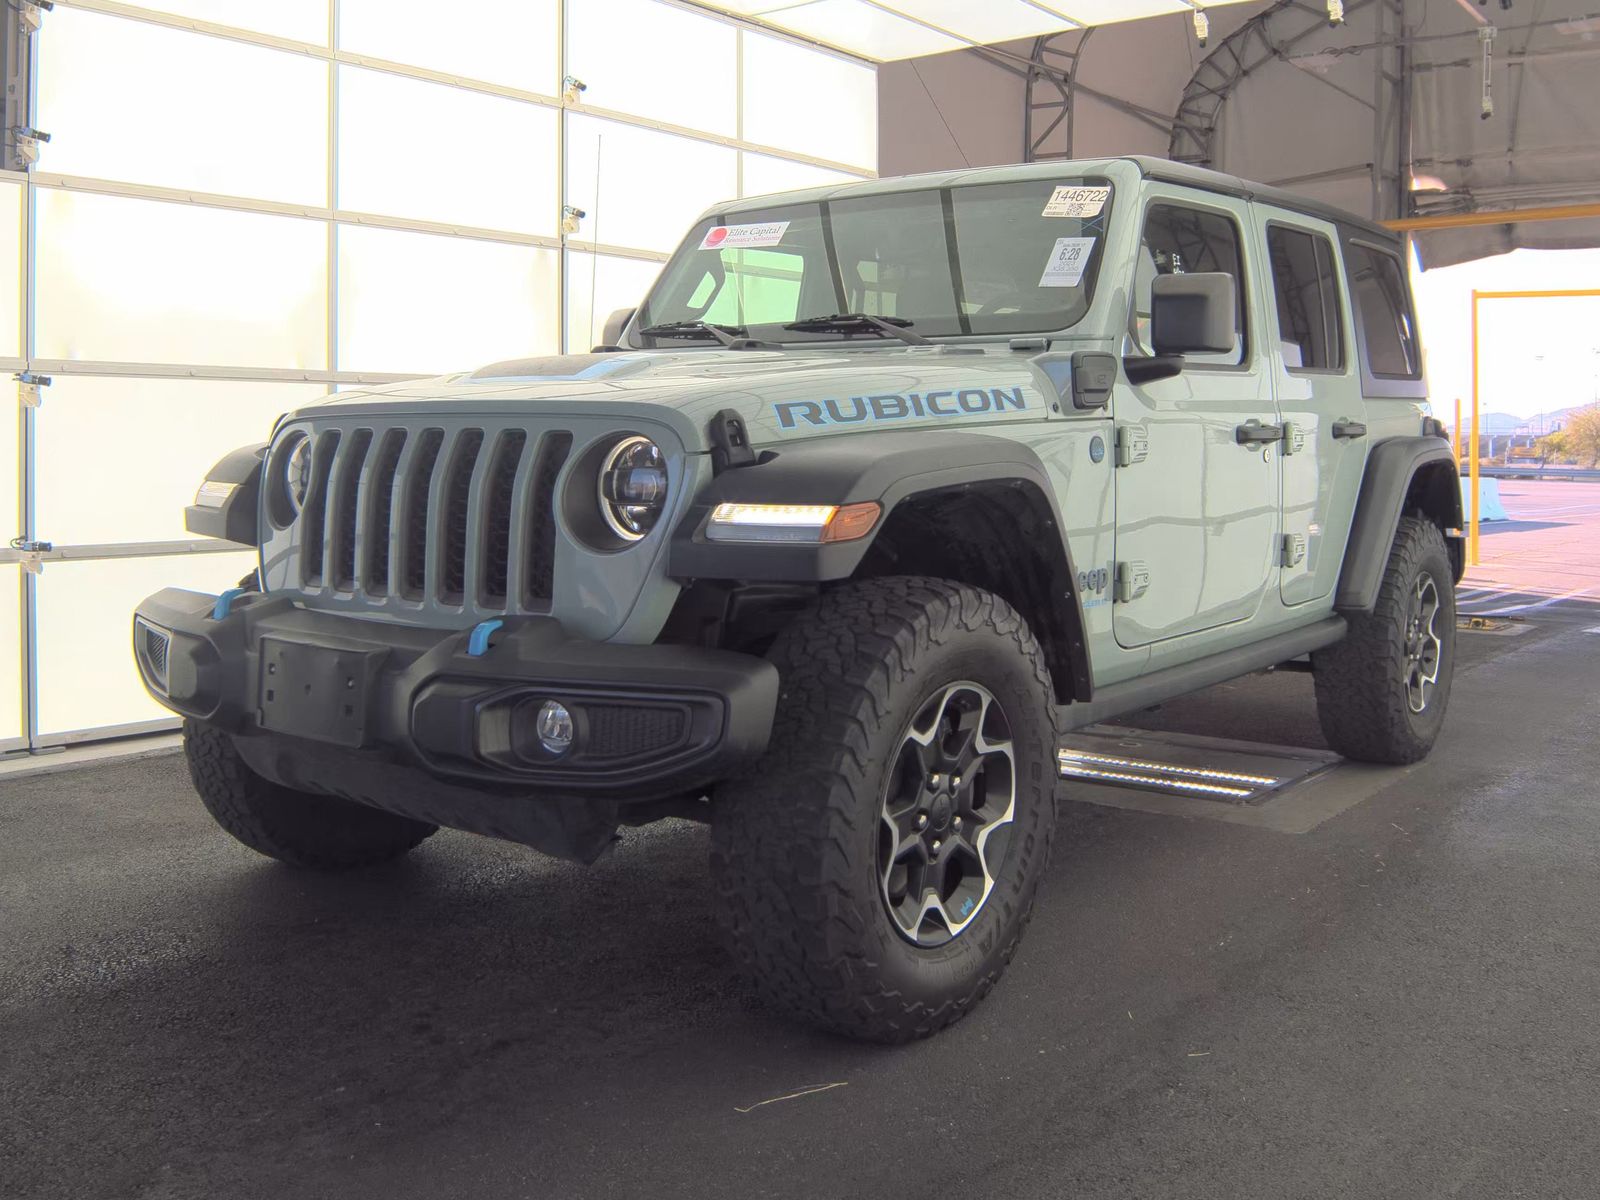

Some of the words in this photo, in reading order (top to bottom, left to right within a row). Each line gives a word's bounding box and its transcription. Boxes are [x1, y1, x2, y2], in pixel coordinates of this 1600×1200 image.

[1055, 190, 1108, 202] 1446722
[728, 229, 748, 237] Elite
[749, 226, 781, 238] Capital
[1059, 247, 1081, 261] 6:28
[773, 387, 1026, 429] RUBICON
[1076, 568, 1109, 595] eep
